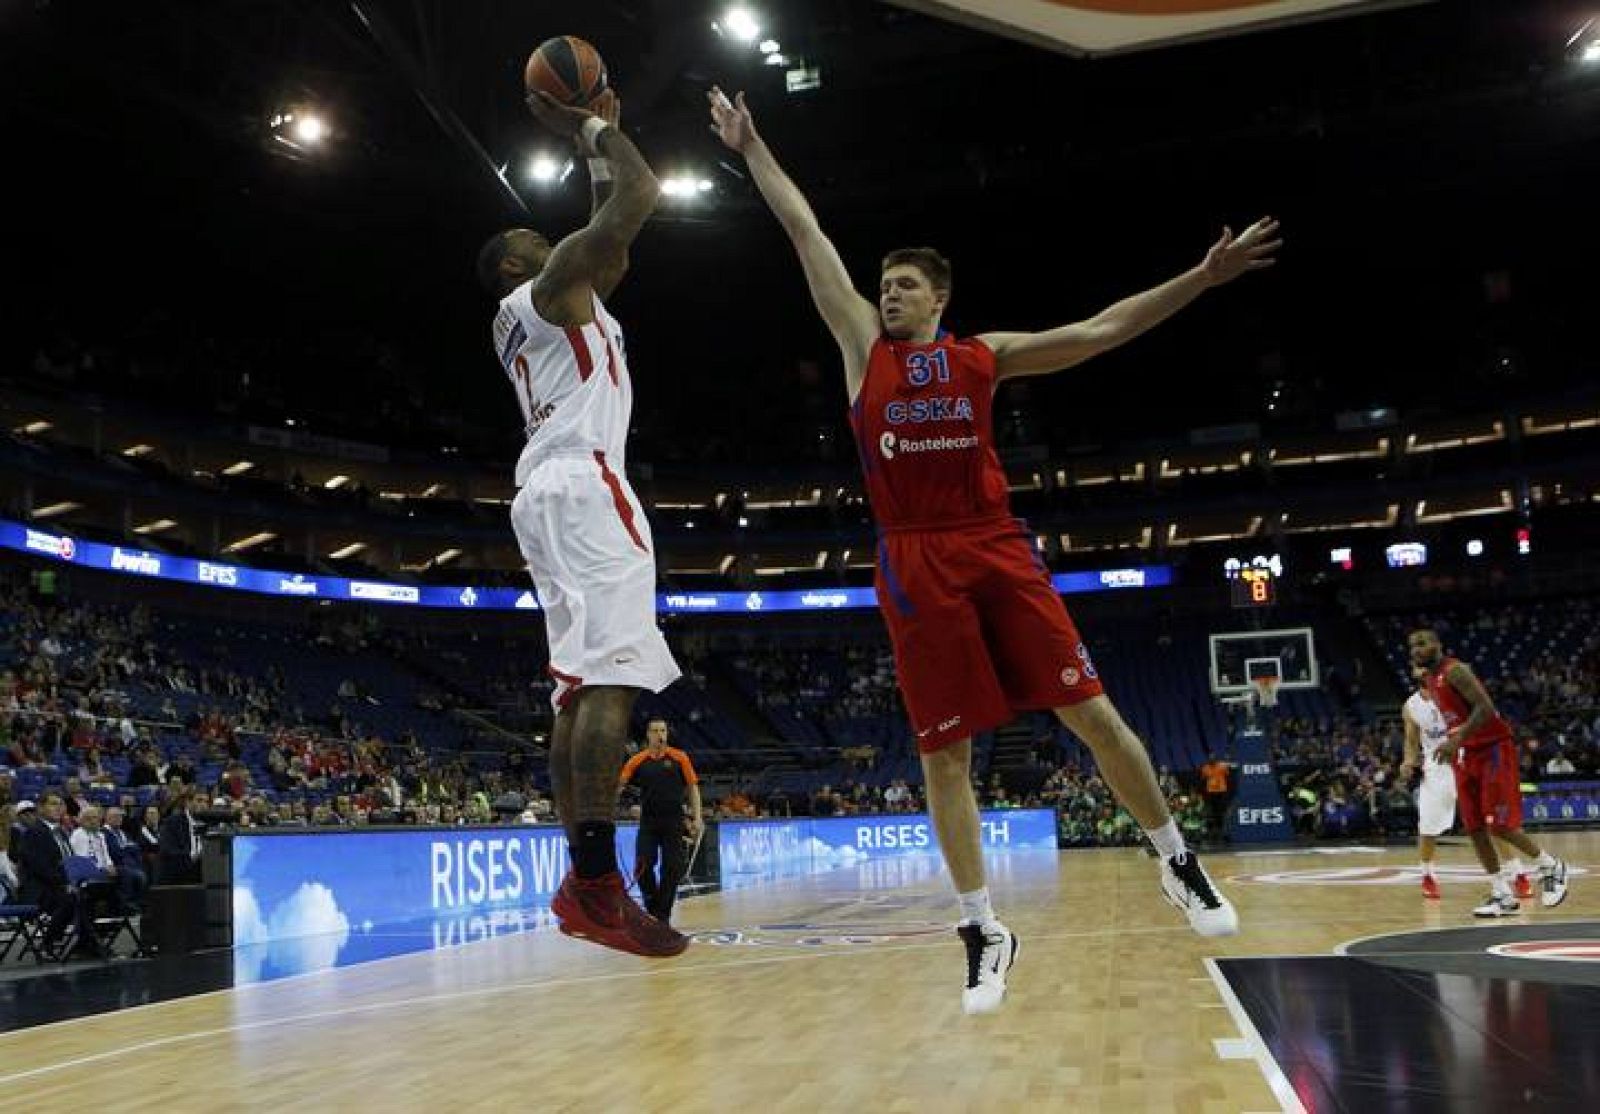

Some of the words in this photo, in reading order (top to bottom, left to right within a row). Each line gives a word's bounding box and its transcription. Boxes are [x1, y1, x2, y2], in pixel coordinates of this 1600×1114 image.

[906, 347, 950, 386] 31
[885, 396, 974, 424] CSKA
[1238, 806, 1284, 825] EFES
[857, 824, 929, 848] RISES
[431, 837, 523, 908] RISES
[530, 835, 570, 895] WI
